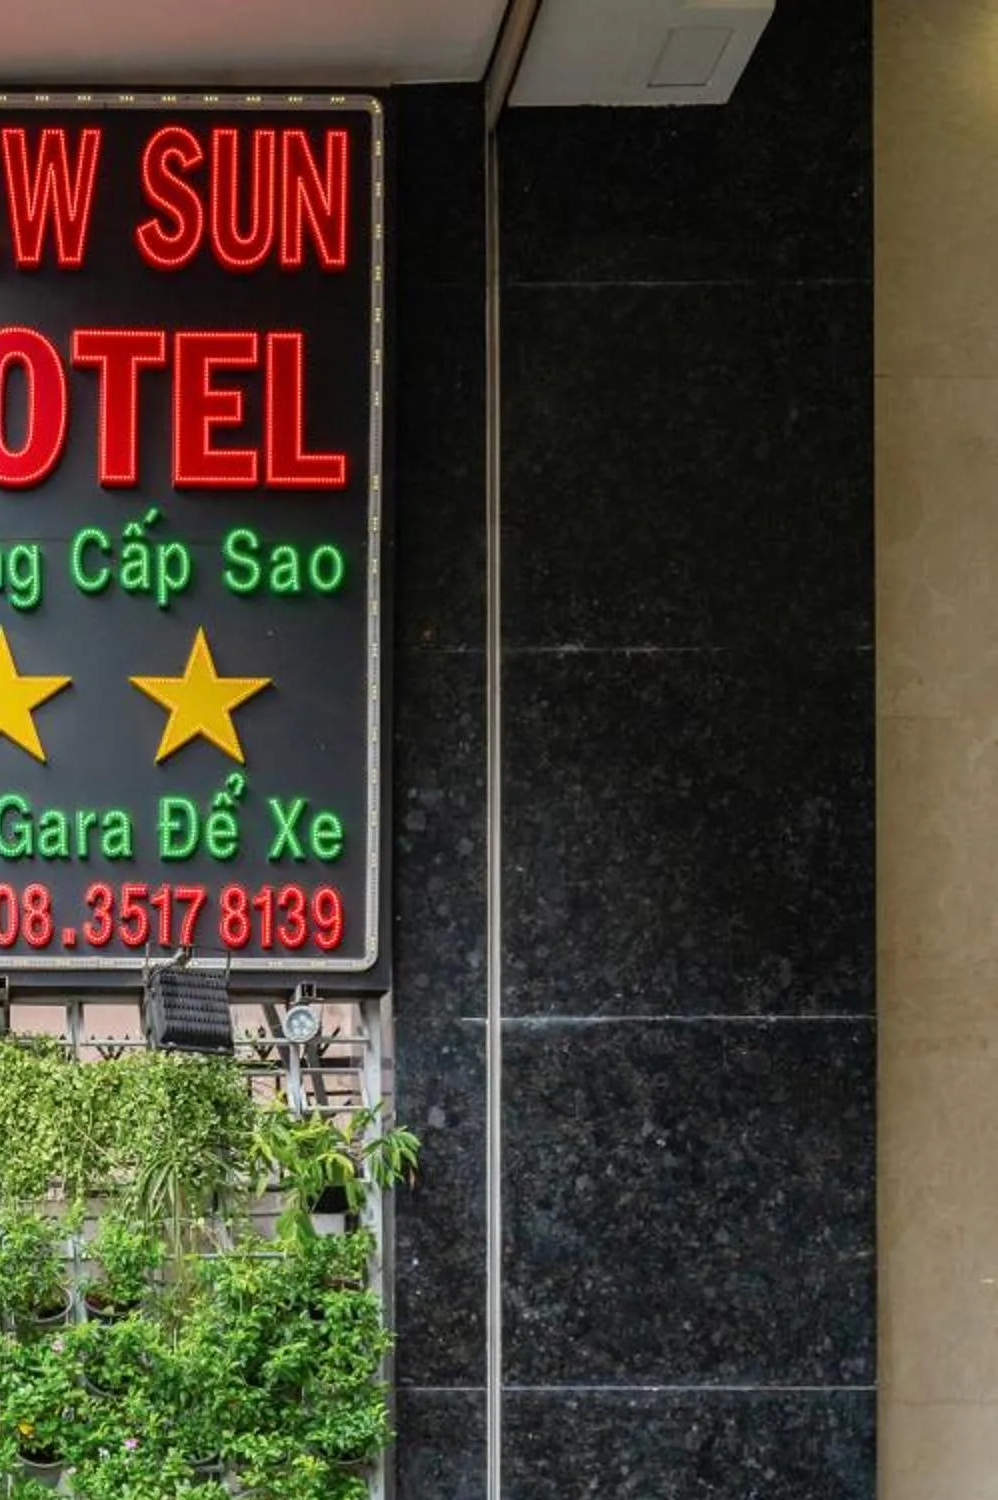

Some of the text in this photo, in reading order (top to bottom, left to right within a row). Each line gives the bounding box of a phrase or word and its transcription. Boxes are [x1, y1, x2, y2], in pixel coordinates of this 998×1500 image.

[138, 127, 348, 271] SUN
[71, 508, 192, 608] Cấp
[224, 528, 345, 593] Sao
[157, 773, 246, 860] Để
[267, 799, 345, 861] Xe
